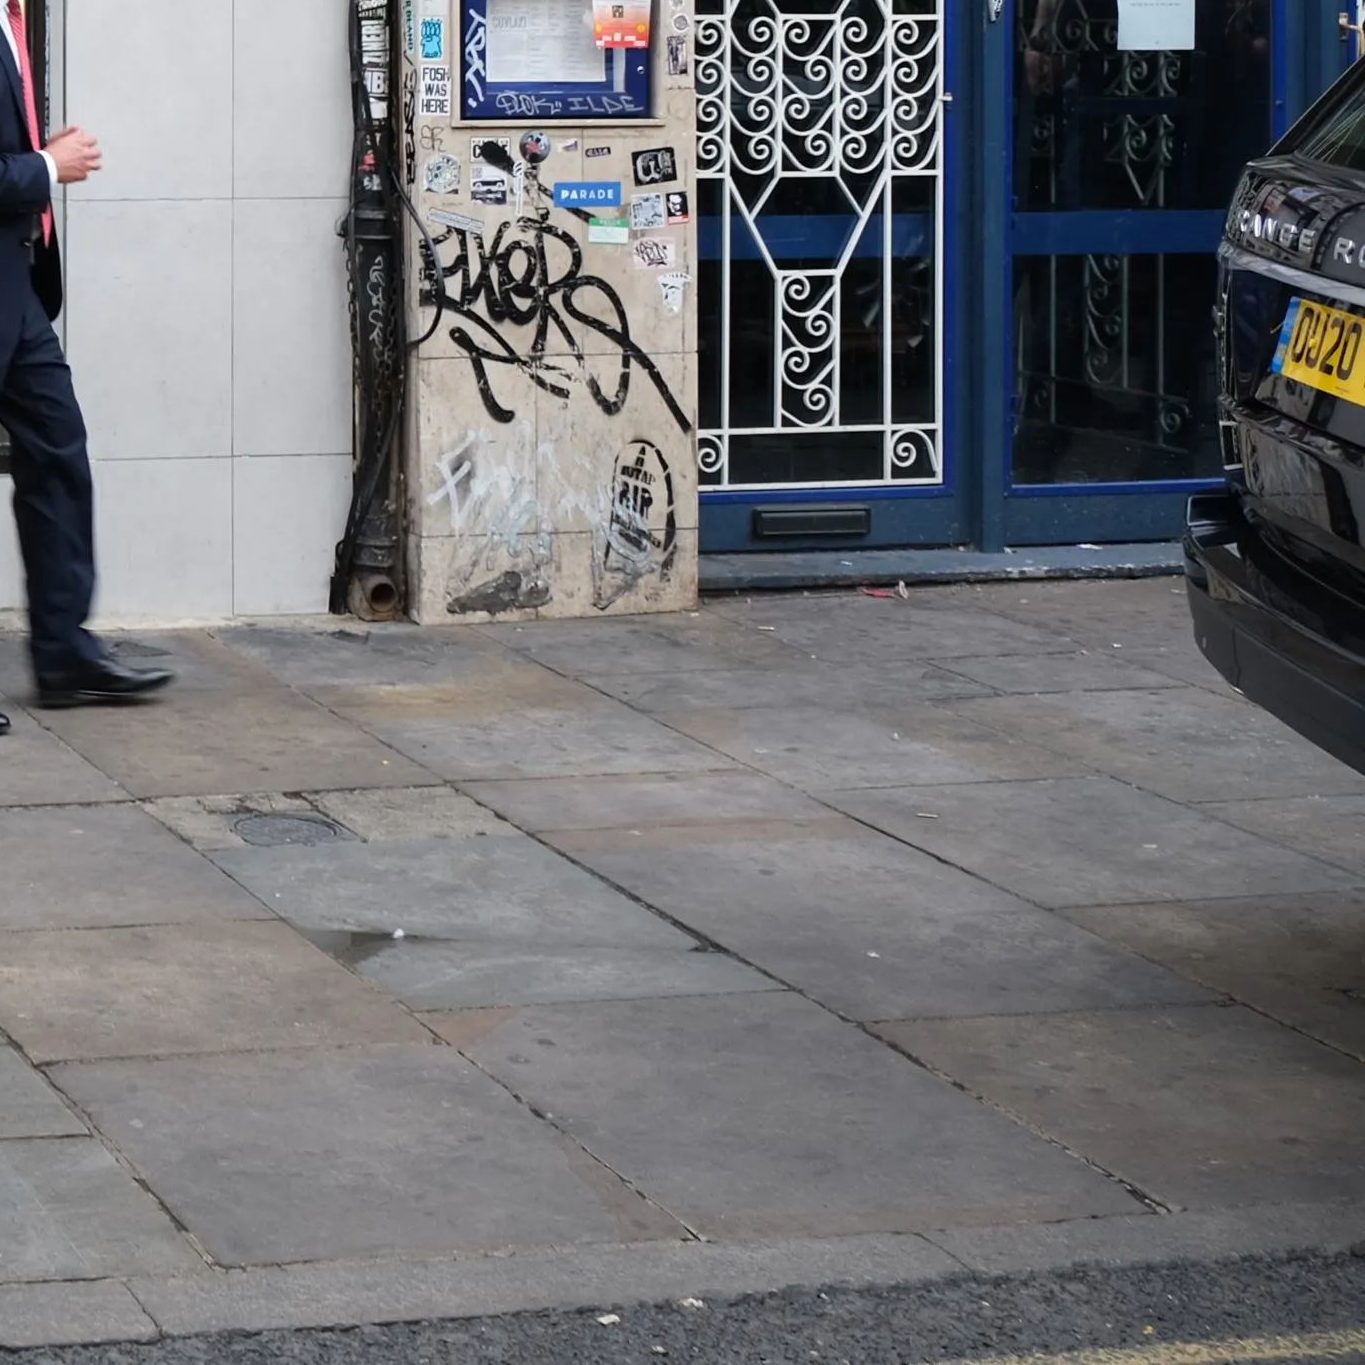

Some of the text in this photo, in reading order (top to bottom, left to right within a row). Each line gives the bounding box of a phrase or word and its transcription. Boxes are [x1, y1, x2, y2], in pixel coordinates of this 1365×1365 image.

[424, 83, 447, 97] WAS
[421, 99, 449, 114] HERE
[560, 189, 614, 201] PARADE
